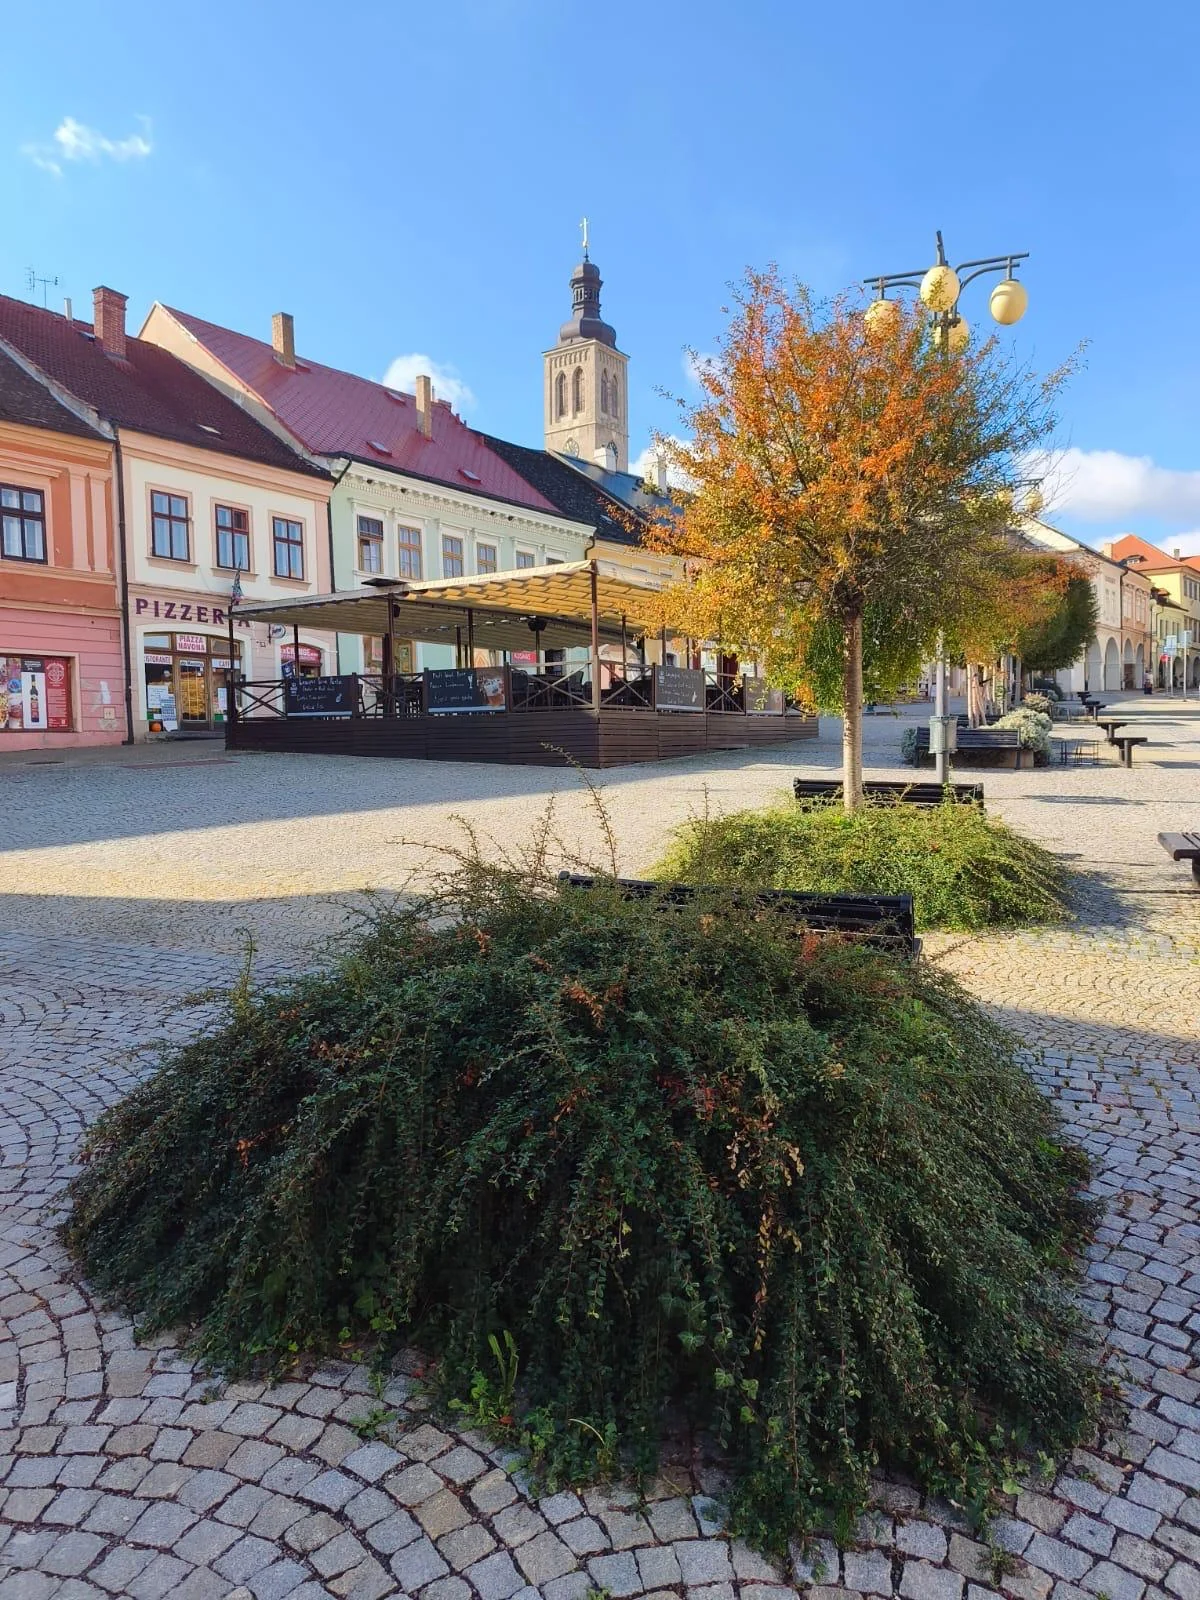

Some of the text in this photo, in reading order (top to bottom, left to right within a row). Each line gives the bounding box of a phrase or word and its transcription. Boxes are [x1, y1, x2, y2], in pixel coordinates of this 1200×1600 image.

[136, 598, 250, 627] PIZZERA
[179, 635, 204, 643] PIAZZA
[178, 642, 206, 651] NAVONA
